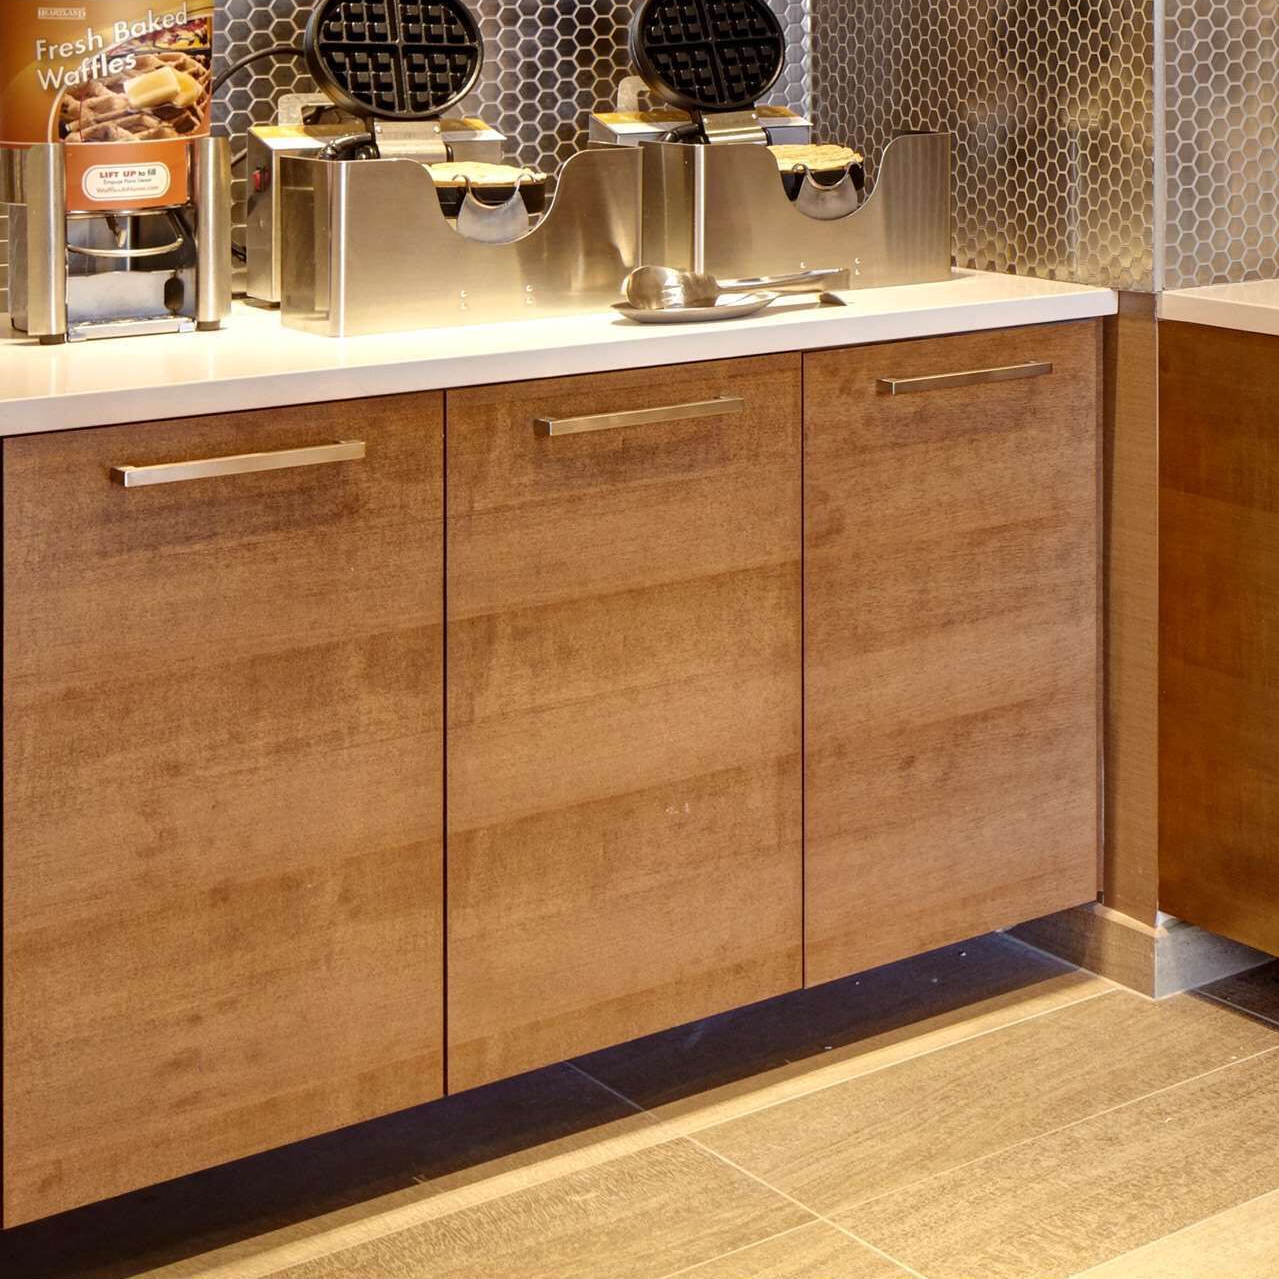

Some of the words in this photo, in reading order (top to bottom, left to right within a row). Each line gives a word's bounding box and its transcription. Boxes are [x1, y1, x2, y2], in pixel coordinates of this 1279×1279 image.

[35, 28, 104, 61] Fresh
[113, 2, 188, 42] Baked
[36, 53, 137, 91] Waffles
[99, 171, 119, 179] LIFT
[123, 170, 137, 178] UP
